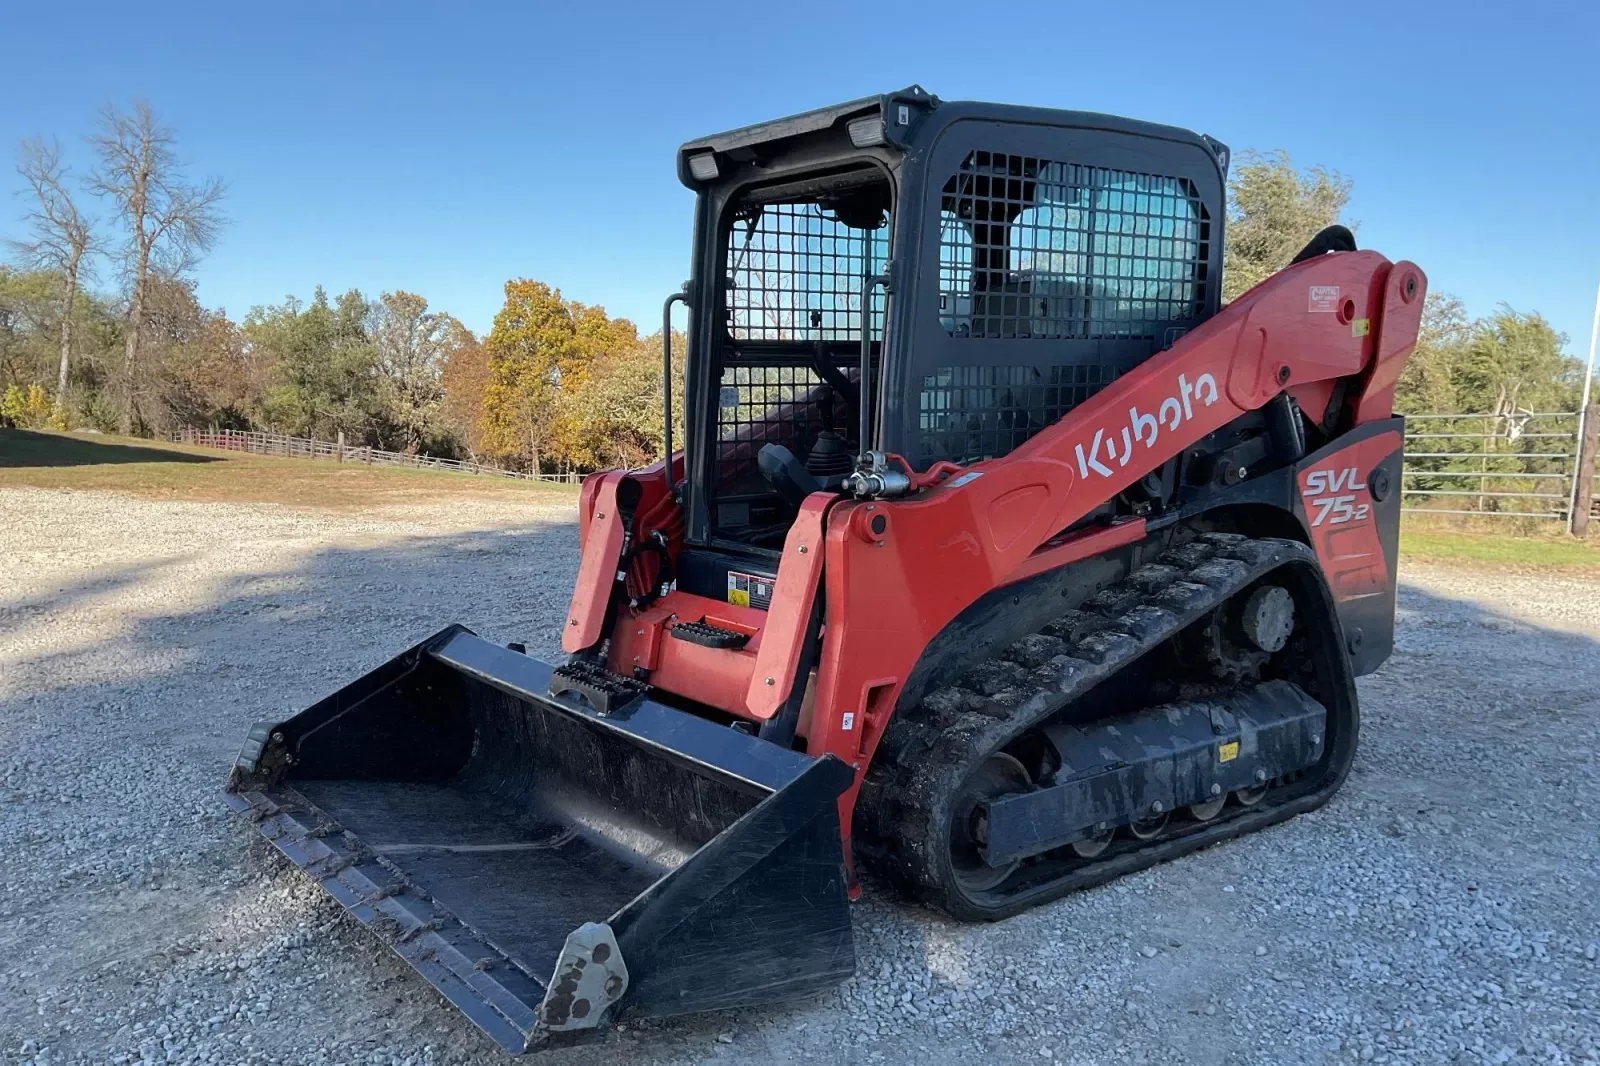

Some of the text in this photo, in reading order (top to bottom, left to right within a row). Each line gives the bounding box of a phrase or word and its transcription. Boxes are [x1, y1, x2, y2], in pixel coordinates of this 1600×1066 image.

[1074, 373, 1218, 480] Kubota
[1303, 468, 1366, 496] SVL
[1311, 495, 1369, 527] 75-2
